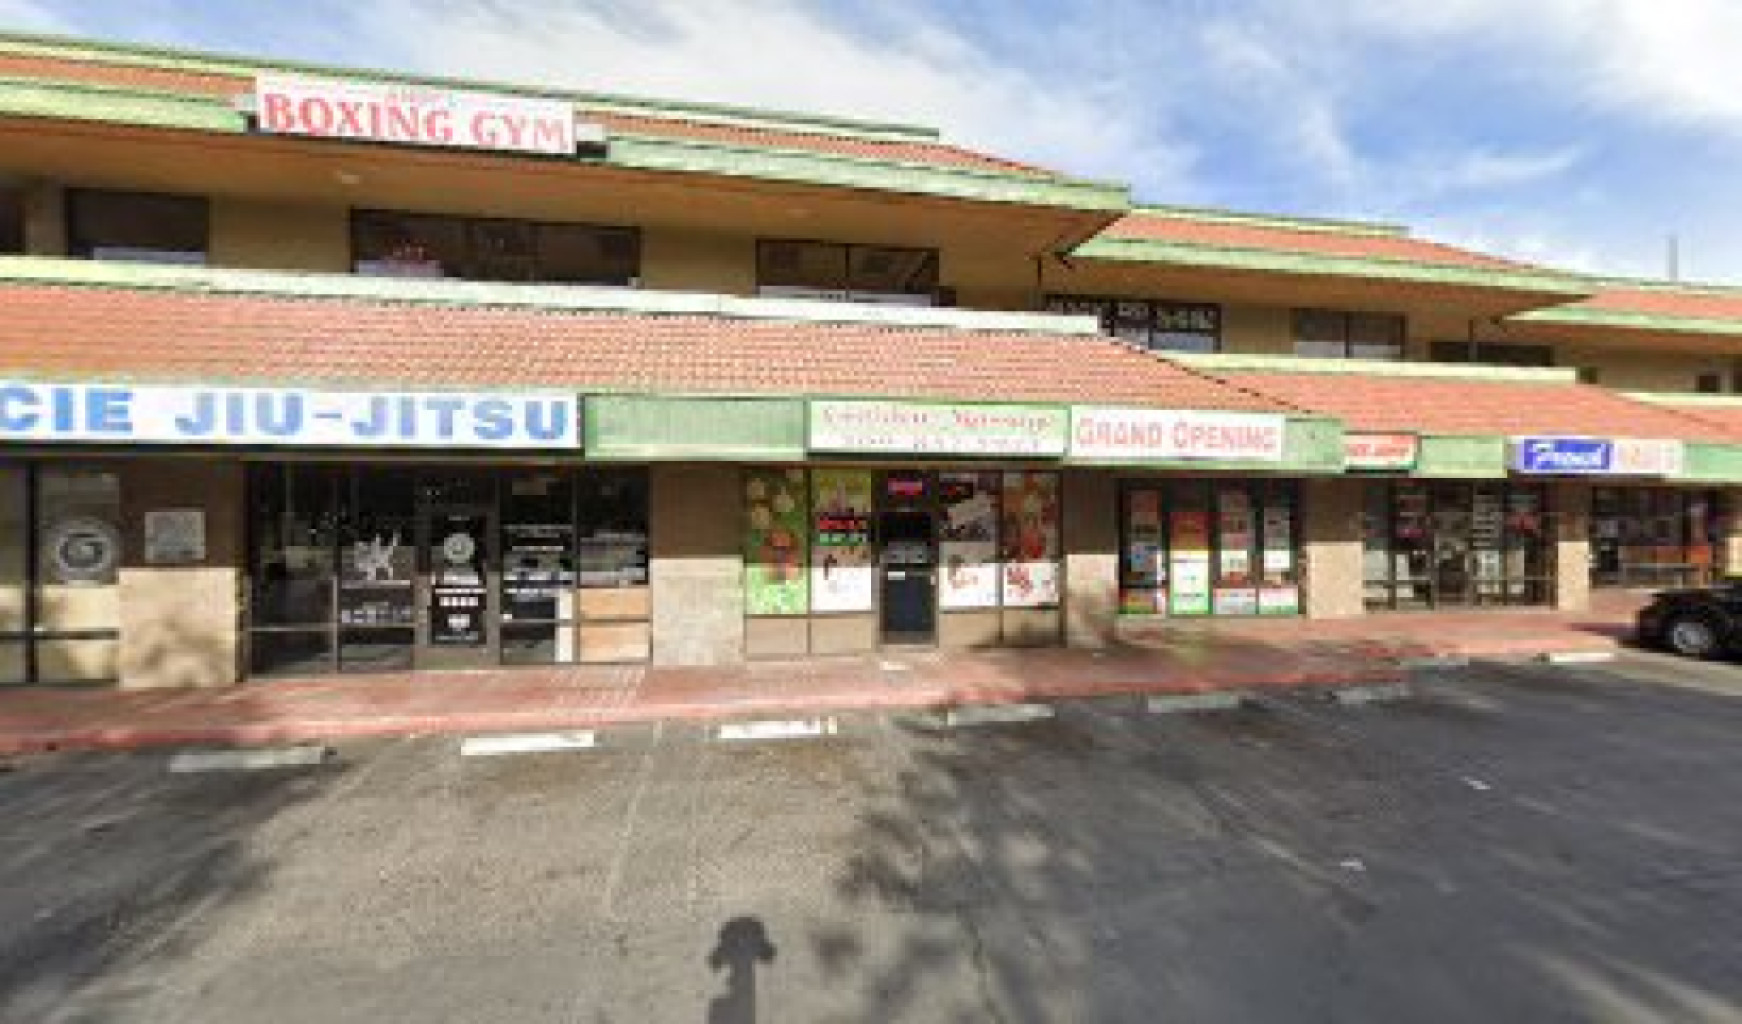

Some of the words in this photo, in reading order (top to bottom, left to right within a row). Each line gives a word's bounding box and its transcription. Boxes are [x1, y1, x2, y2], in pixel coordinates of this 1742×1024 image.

[263, 93, 454, 142] BOXING
[470, 109, 568, 151] GYM
[0, 386, 134, 434] CIE
[174, 391, 569, 441] JIU-JITSU
[1077, 417, 1163, 449] GRAND
[1172, 419, 1278, 453] OPENING
